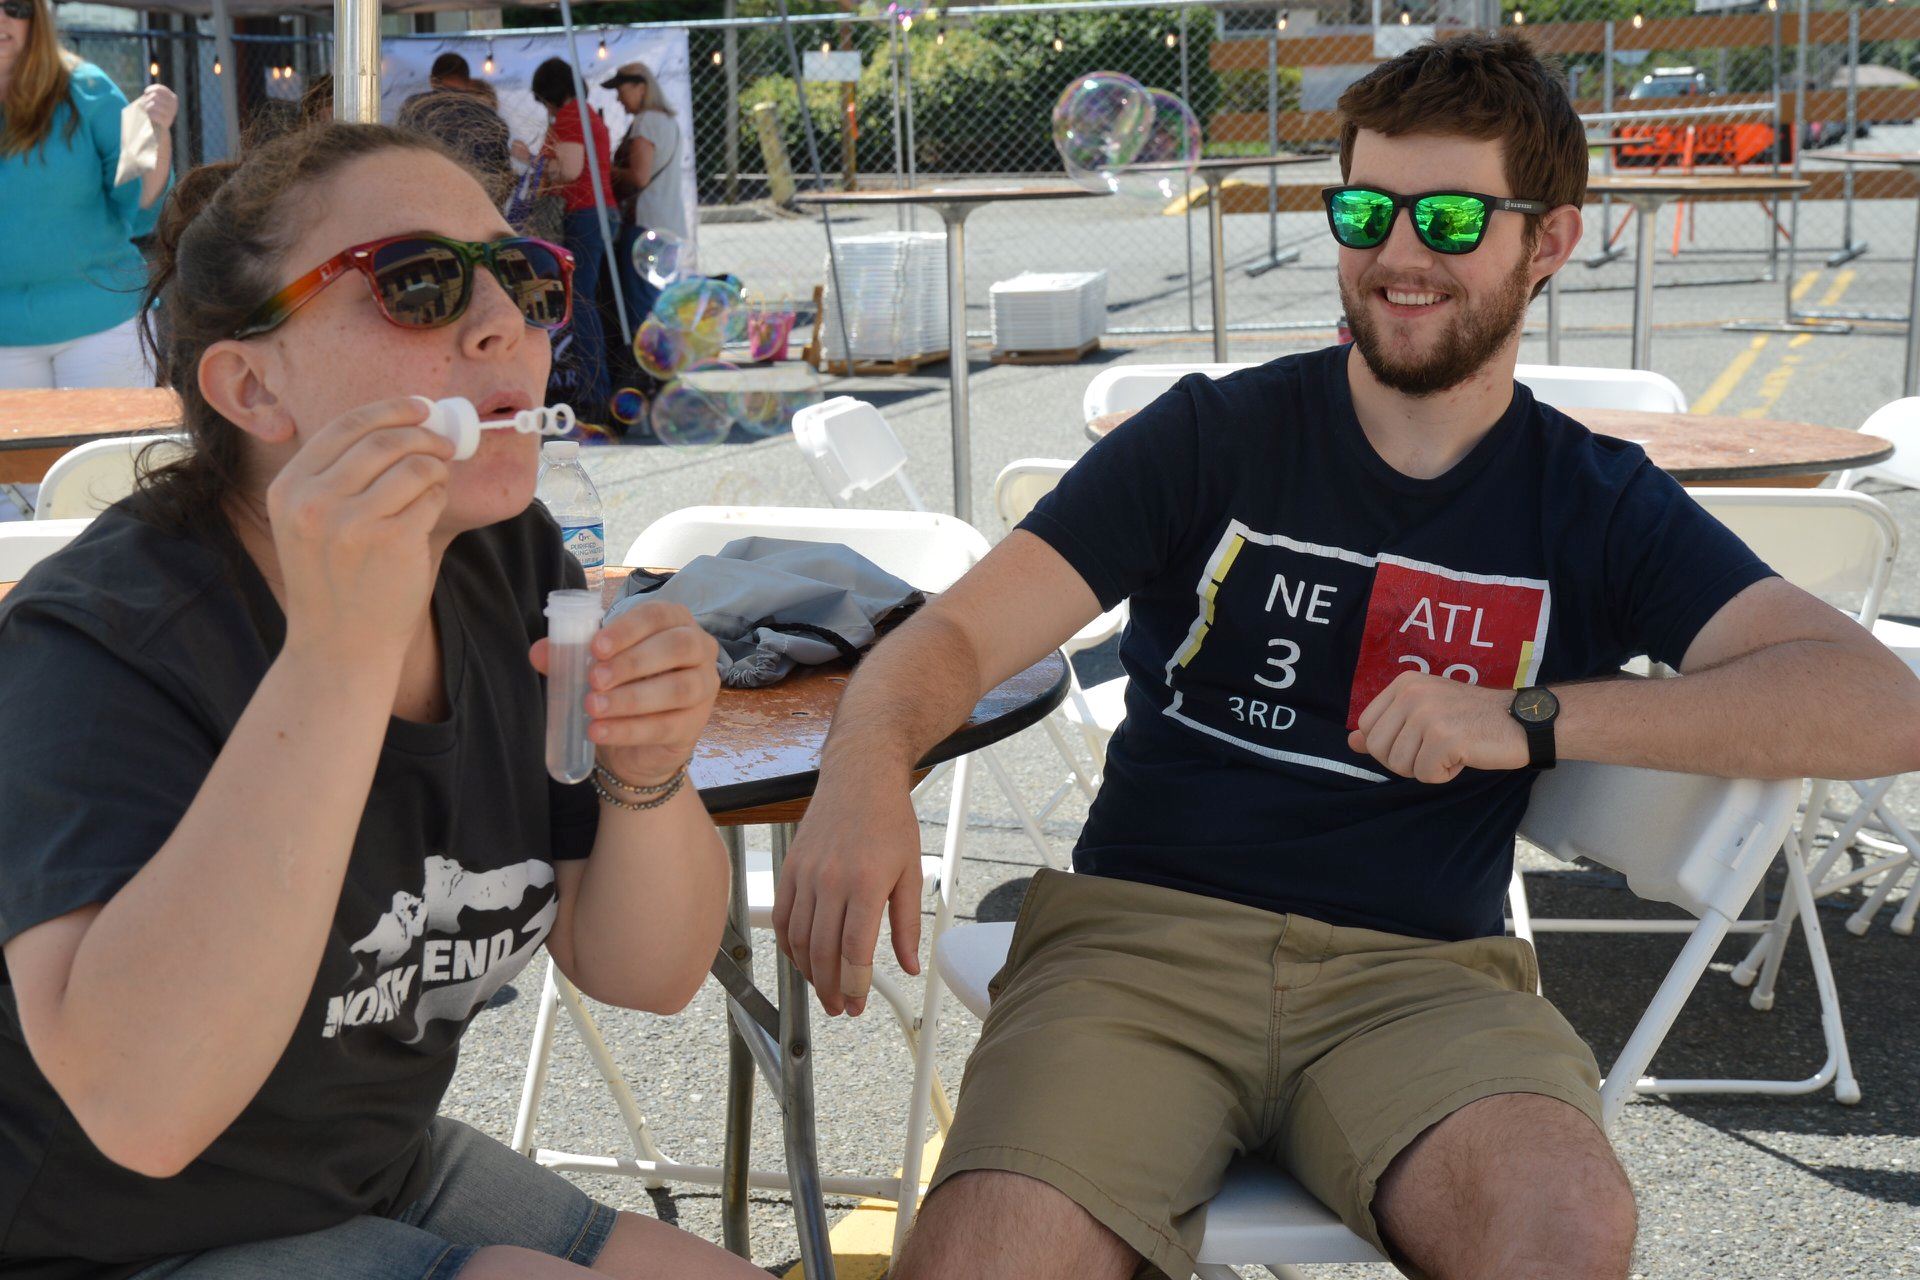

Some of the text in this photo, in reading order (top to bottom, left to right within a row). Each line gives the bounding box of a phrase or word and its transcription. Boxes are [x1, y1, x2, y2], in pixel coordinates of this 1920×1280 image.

[1265, 573, 1338, 624] NE
[1399, 597, 1494, 648] ATL
[1254, 639, 1301, 689] 3
[1228, 696, 1296, 730] 3RD
[322, 928, 514, 1038] NORTH END
